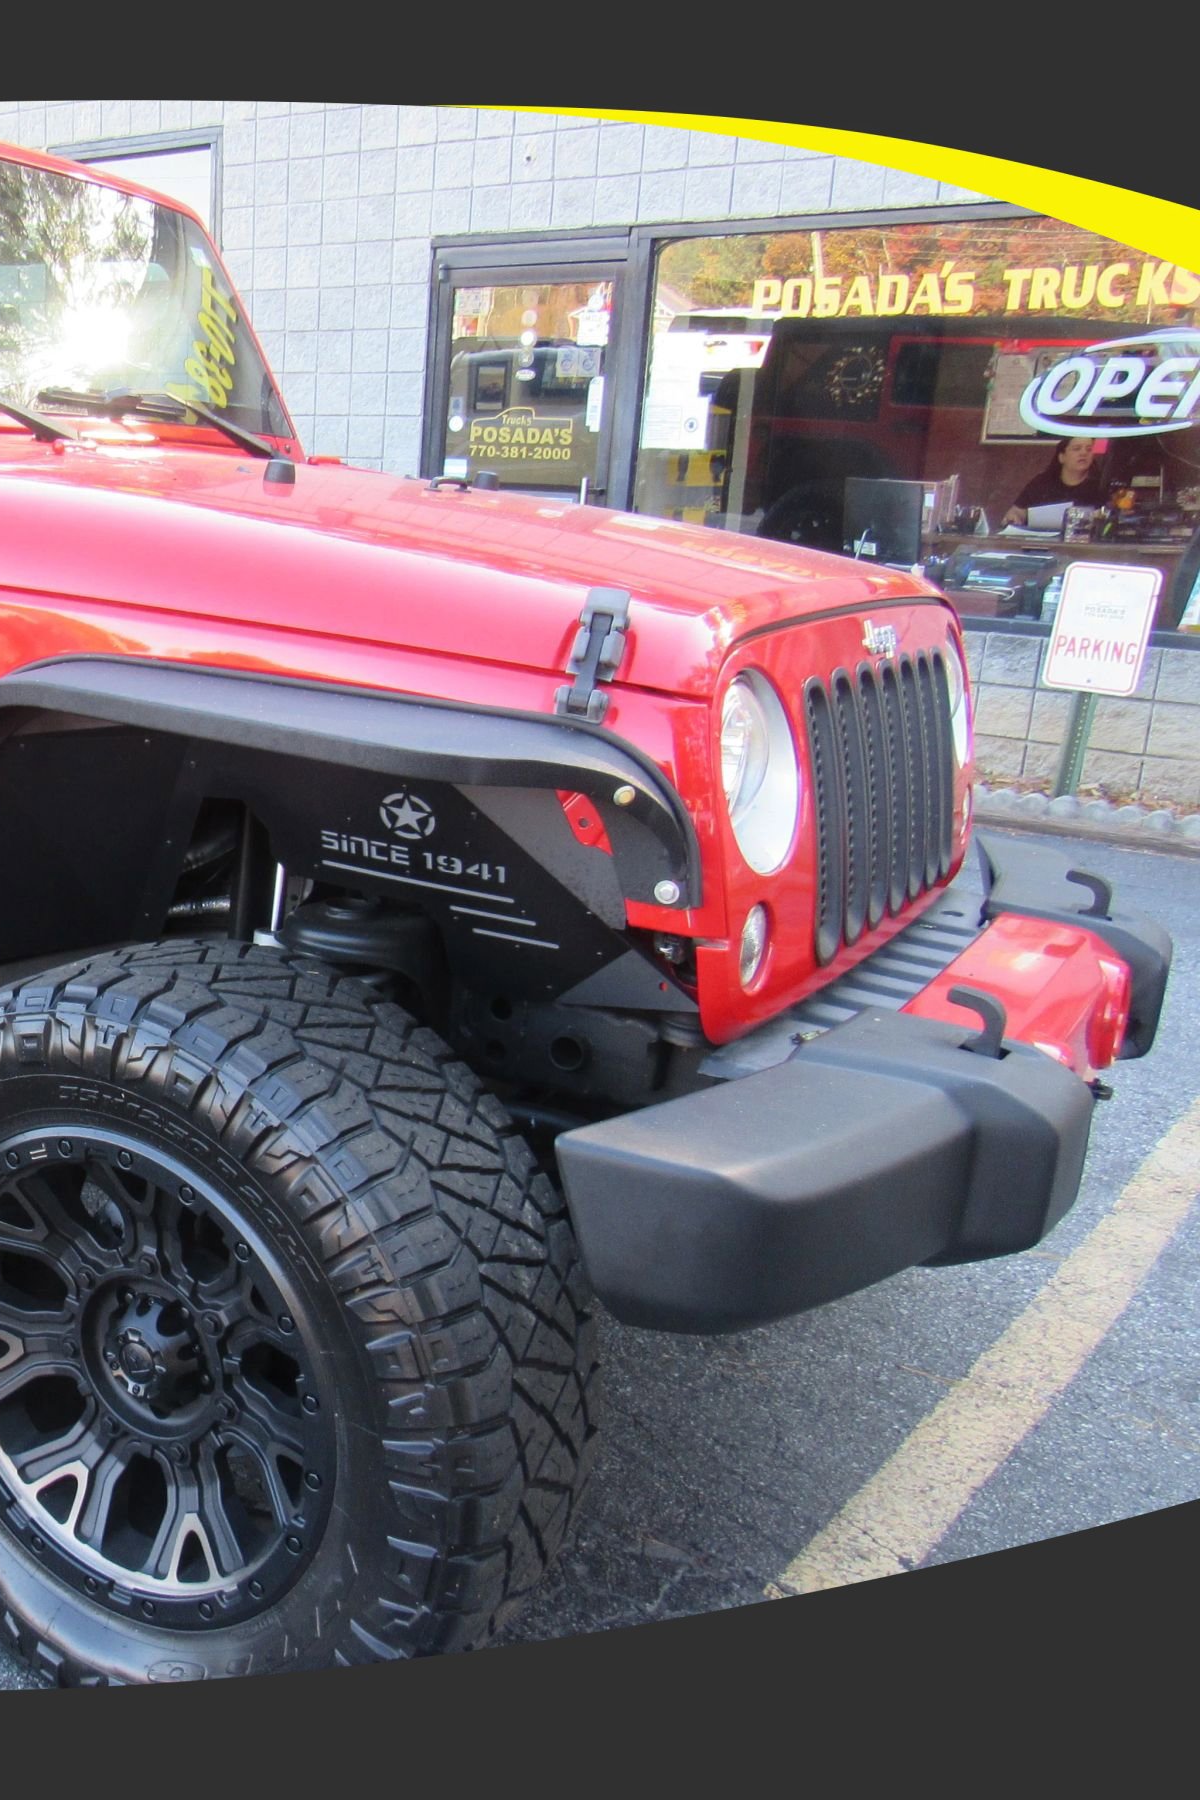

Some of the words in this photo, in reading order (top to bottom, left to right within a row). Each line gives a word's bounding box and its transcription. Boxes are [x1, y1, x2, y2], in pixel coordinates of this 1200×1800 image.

[752, 262, 976, 317] POSADA'S
[1003, 261, 1200, 311] TRUCKS
[502, 414, 532, 426] Trucks
[469, 426, 573, 446] POSADA'S
[469, 445, 571, 461] 770-381-2000
[1054, 635, 1138, 665] PARKING
[320, 829, 411, 866] SINCE
[423, 852, 506, 884] 1941
